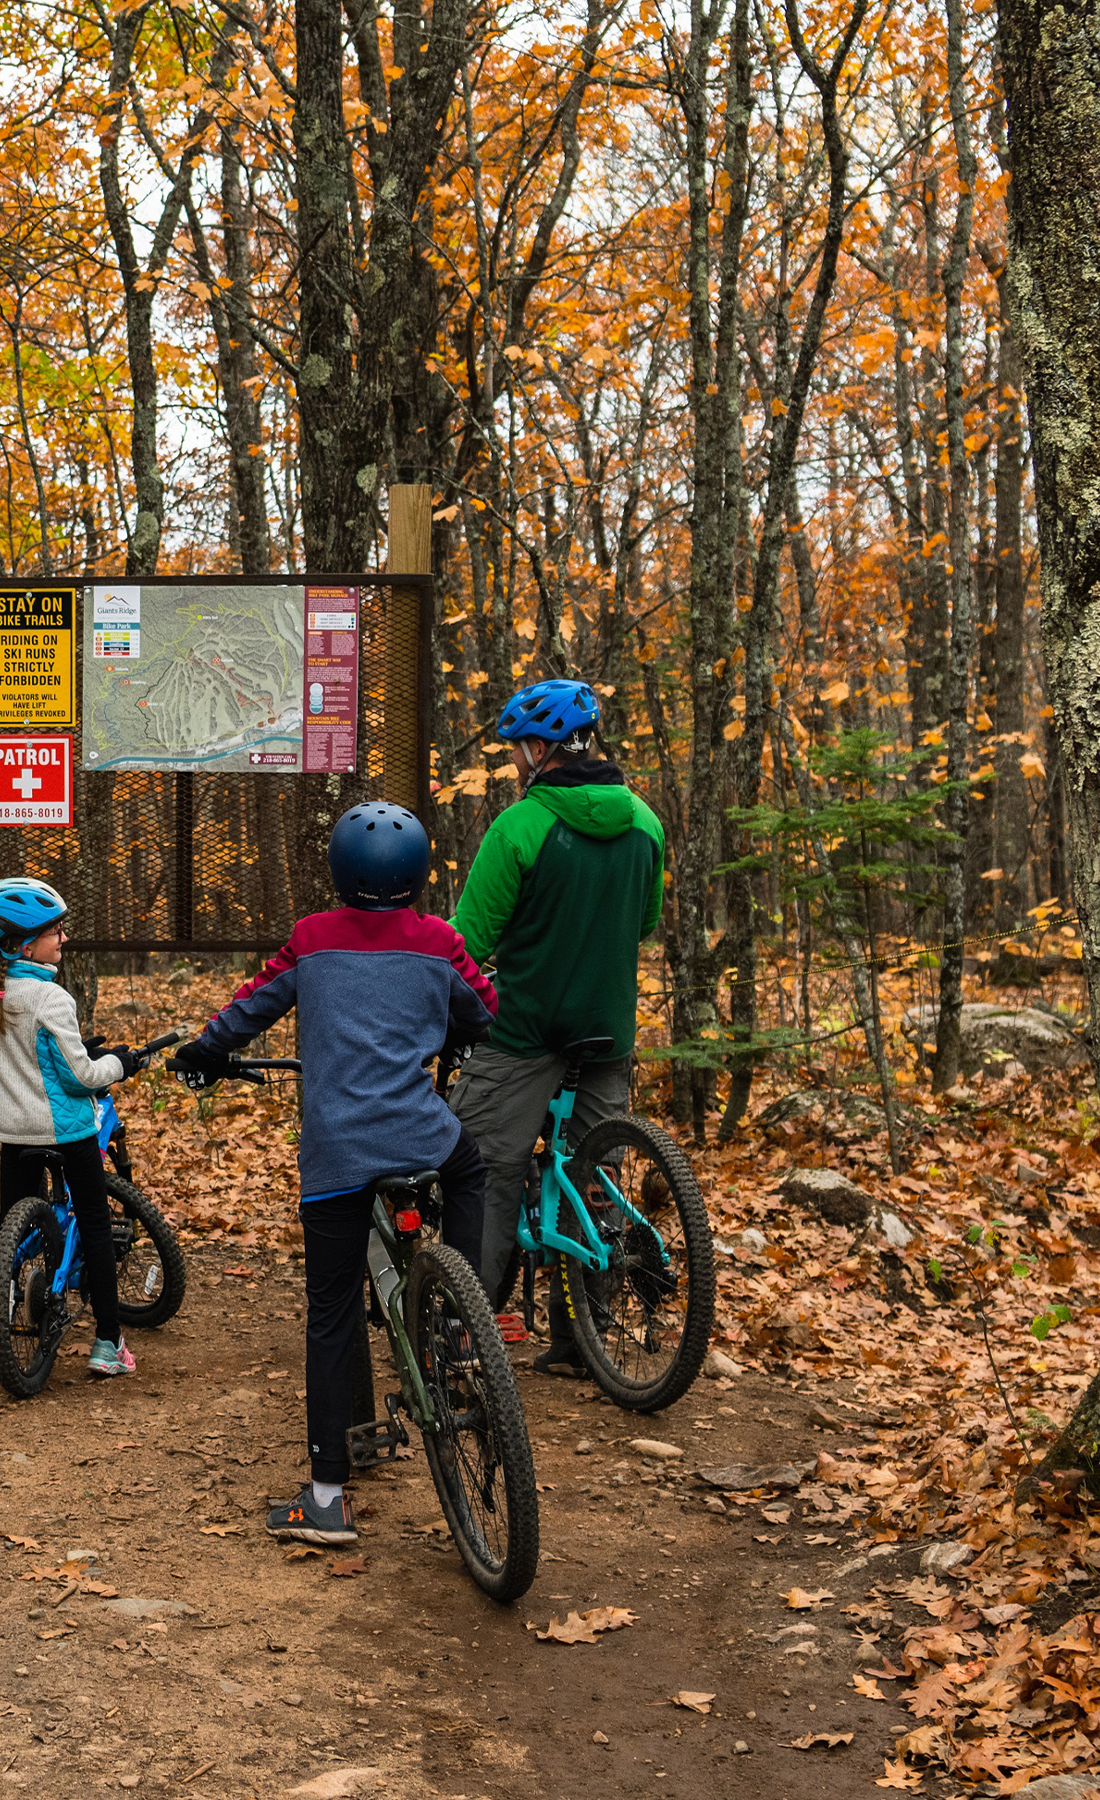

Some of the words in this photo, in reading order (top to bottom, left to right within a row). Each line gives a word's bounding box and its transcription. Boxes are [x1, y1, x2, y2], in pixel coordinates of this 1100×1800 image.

[42, 597, 62, 612] ON
[119, 607, 136, 615] Ridge
[25, 614, 63, 626] TRAILS
[1, 635, 38, 646] RIDING
[43, 635, 58, 645] ON
[4, 649, 21, 659] SKI
[26, 649, 55, 659] RUNS
[4, 662, 55, 672] STRICTLY
[0, 675, 61, 686] FORBIDDEN
[560, 1253, 576, 1319] MAXXIS
